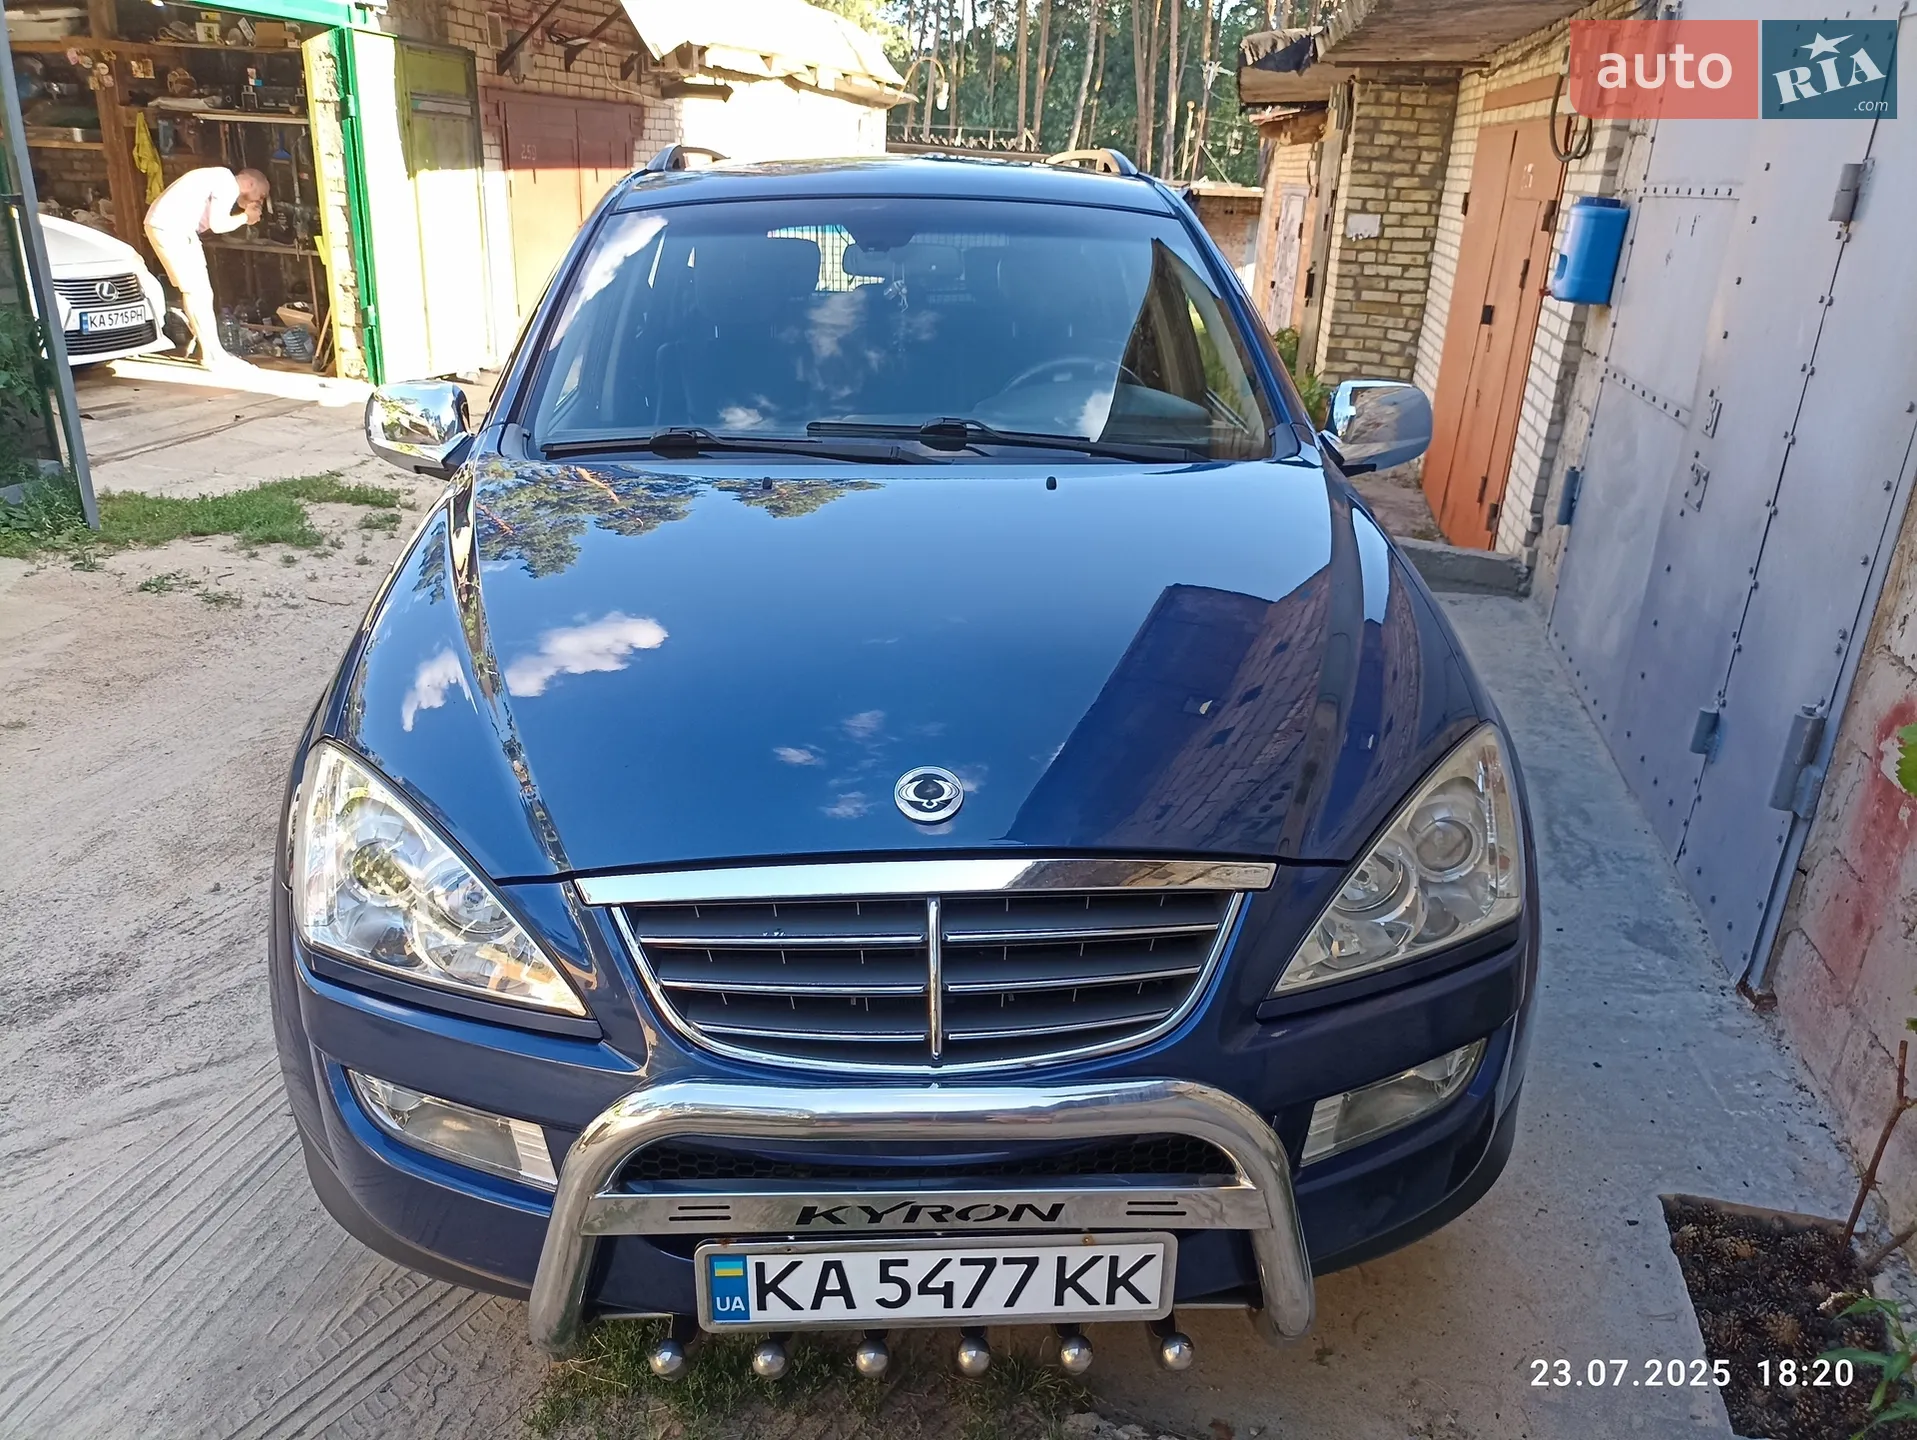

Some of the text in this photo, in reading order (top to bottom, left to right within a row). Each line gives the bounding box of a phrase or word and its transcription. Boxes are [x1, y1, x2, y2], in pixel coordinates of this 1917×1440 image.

[89, 309, 143, 328] KA 5715 PH
[795, 1201, 1065, 1226] KYRON
[754, 1254, 1157, 1311] KA 5477 KK
[716, 1297, 745, 1312] UA
